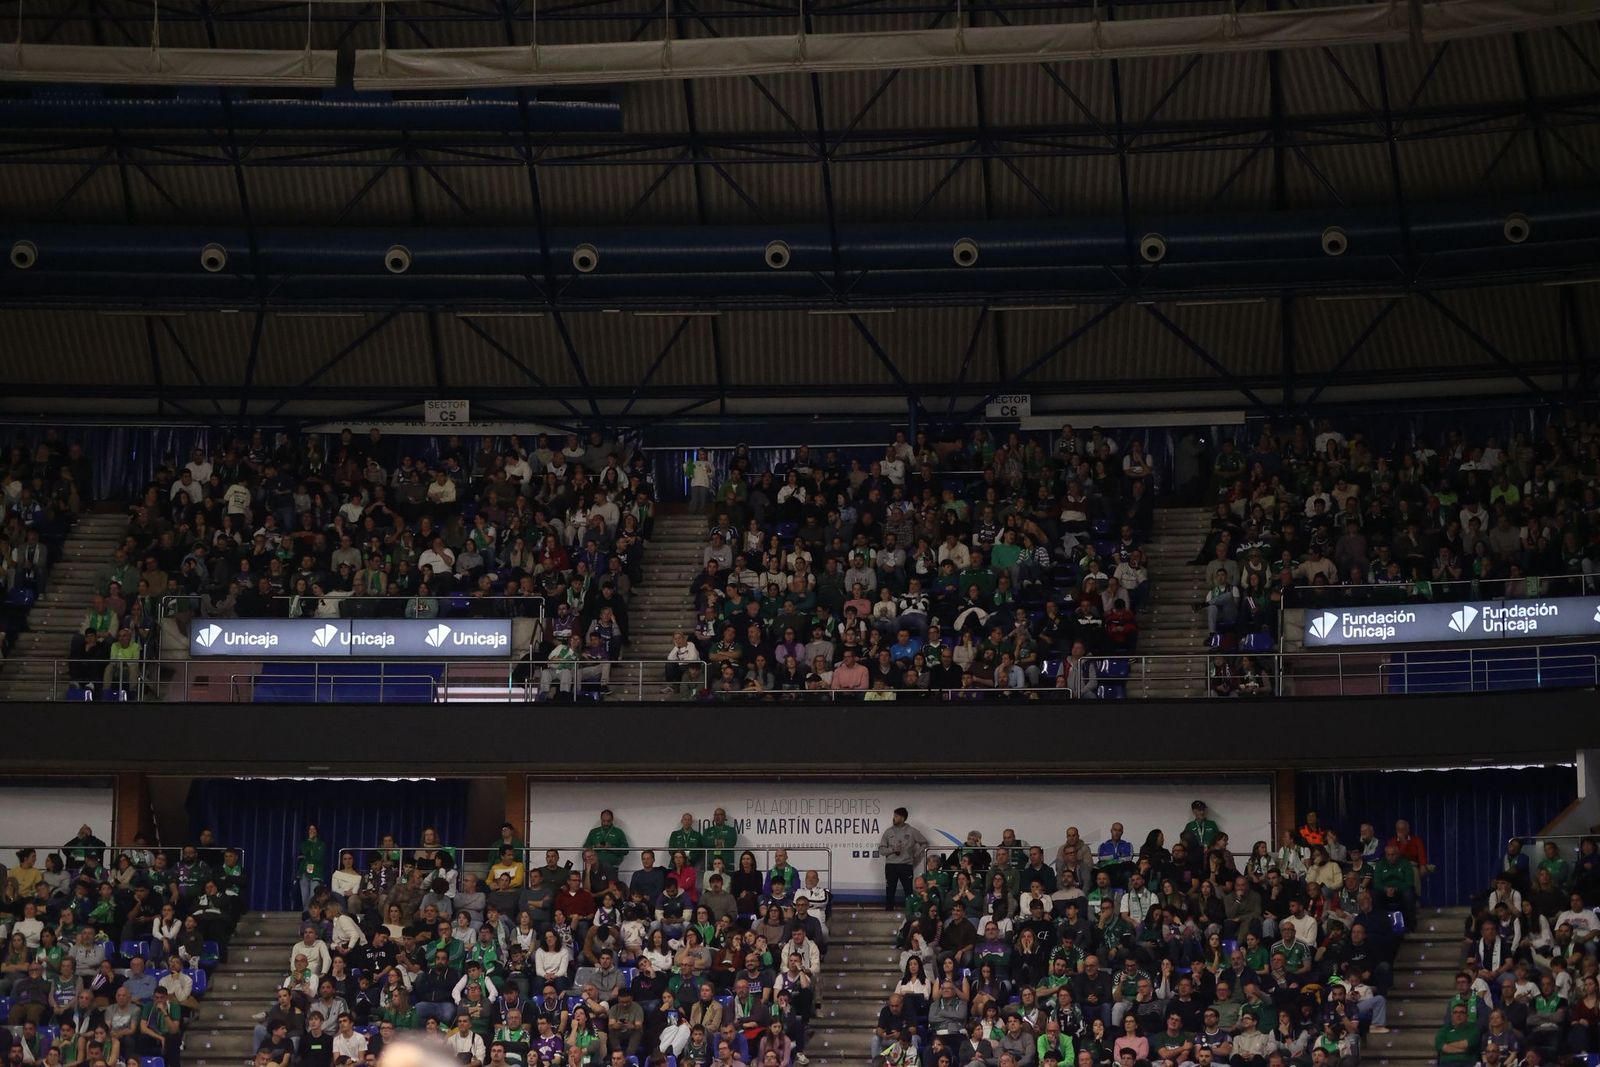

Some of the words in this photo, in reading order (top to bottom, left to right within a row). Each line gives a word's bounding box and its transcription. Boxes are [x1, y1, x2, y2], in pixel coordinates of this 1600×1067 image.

[428, 401, 466, 409] SECTOR
[992, 396, 1028, 404] ECTOR
[439, 411, 457, 421] C5
[1001, 406, 1017, 416] C6
[1342, 610, 1416, 625] Fundación
[1483, 602, 1558, 619] Fundación
[1342, 624, 1396, 640] Unicaja
[1483, 617, 1537, 634] Unicaja
[224, 631, 279, 648] Unicaja
[340, 631, 395, 648] Unicaja
[453, 631, 507, 648] Unicaja
[746, 799, 797, 815] PALACIO
[801, 799, 816, 815] DE
[819, 799, 881, 815] DEPORTES
[757, 815, 810, 834] MARTÍN
[815, 818, 880, 834] CARPENA
